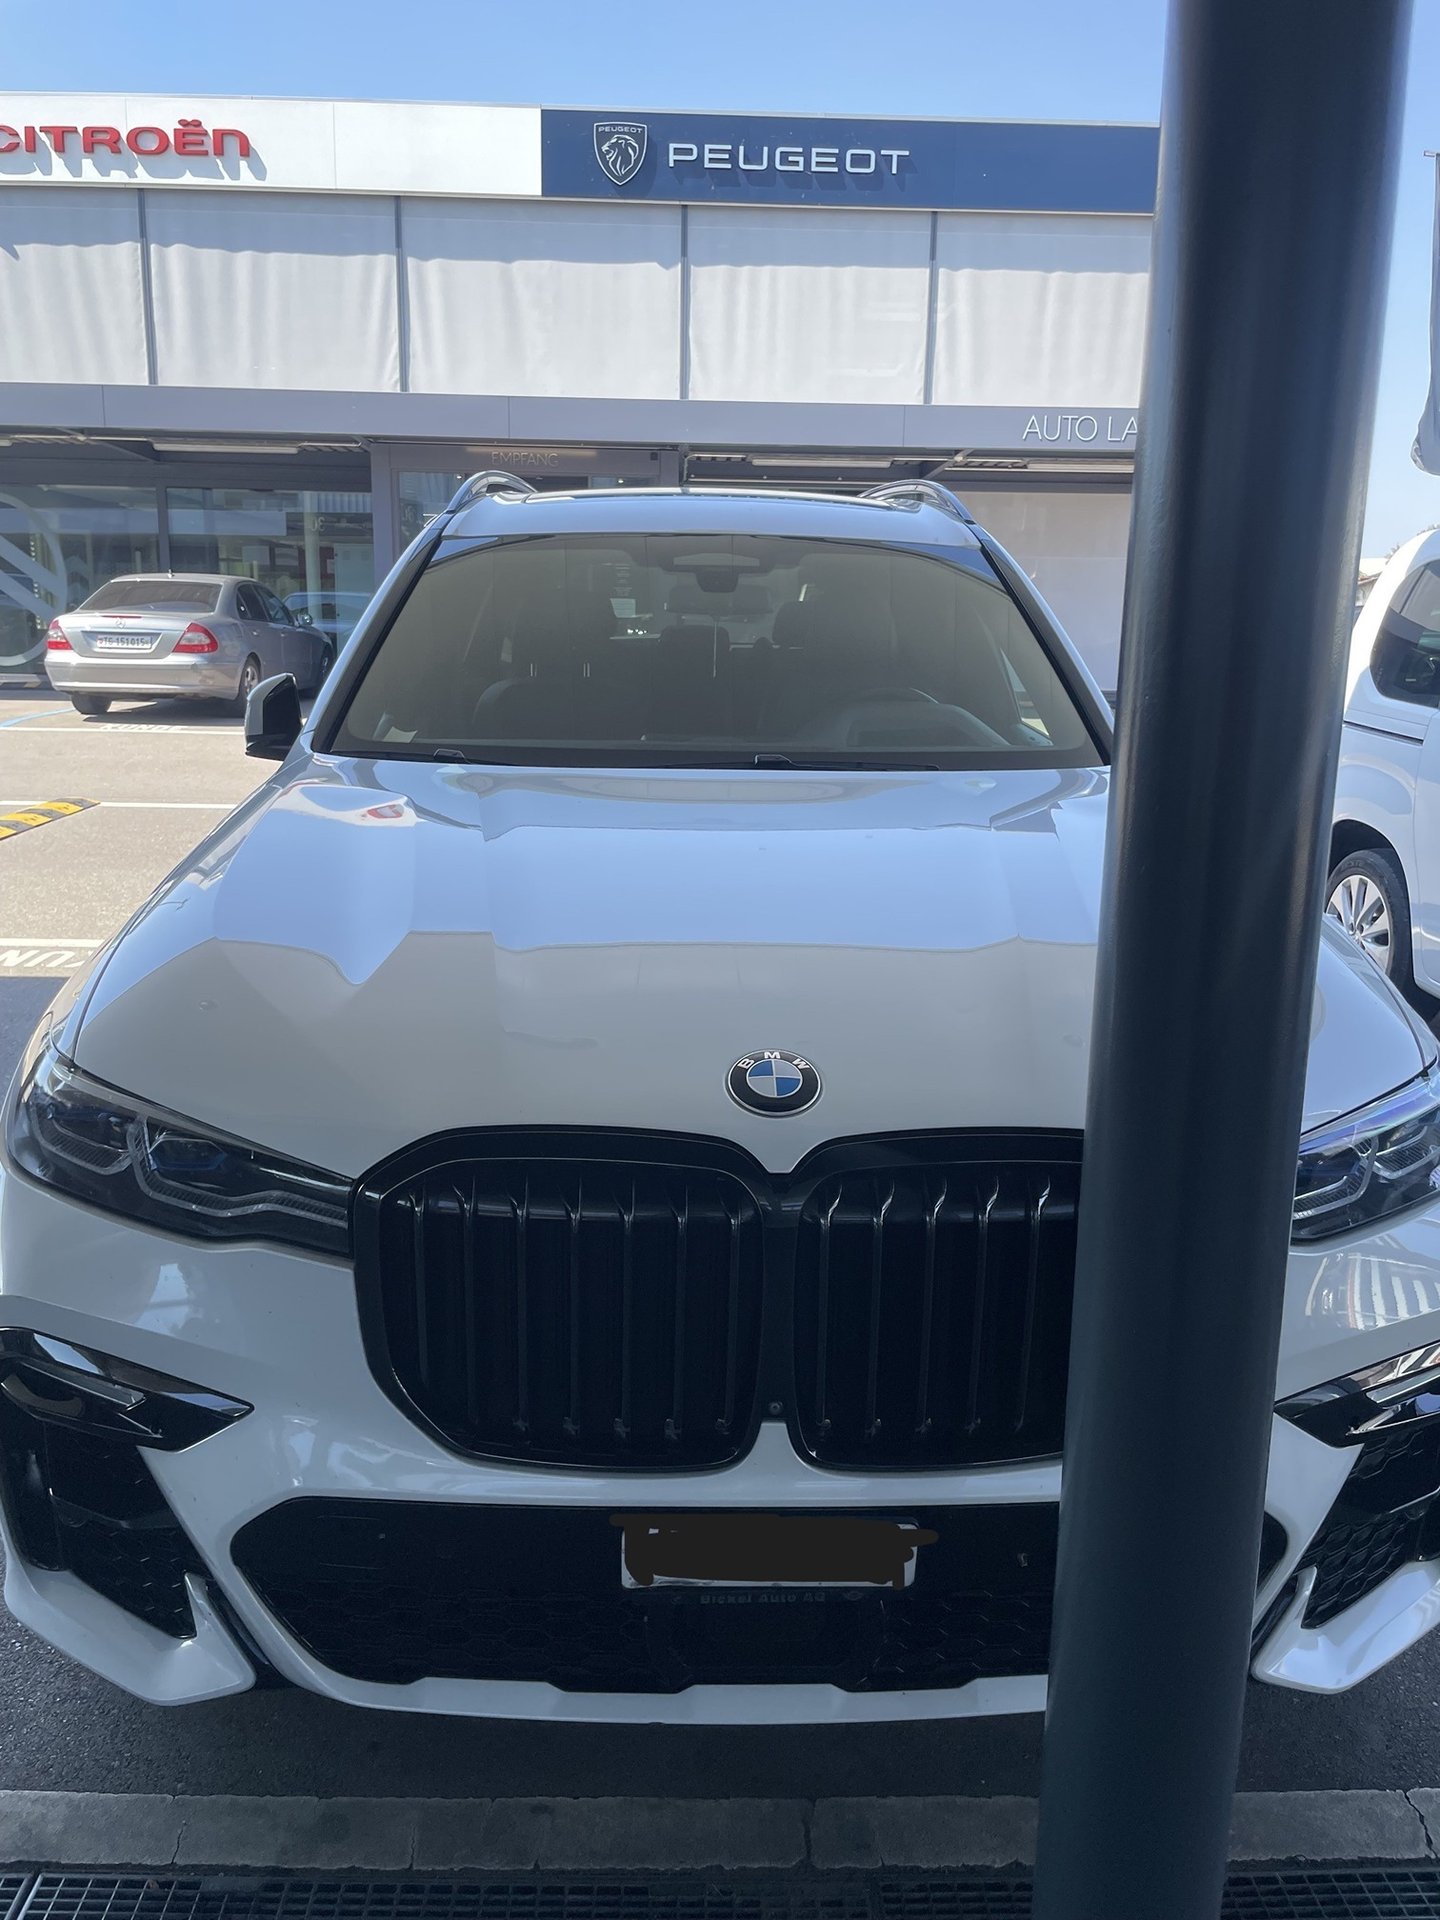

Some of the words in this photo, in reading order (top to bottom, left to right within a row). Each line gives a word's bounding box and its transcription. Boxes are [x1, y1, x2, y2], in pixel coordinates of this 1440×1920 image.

[668, 143, 910, 174] PEUGEOT
[1022, 415, 1098, 441] AUTO
[491, 451, 559, 467] EMPFANG
[737, 1051, 811, 1070] BMW
[759, 1592, 797, 1603] Auto
